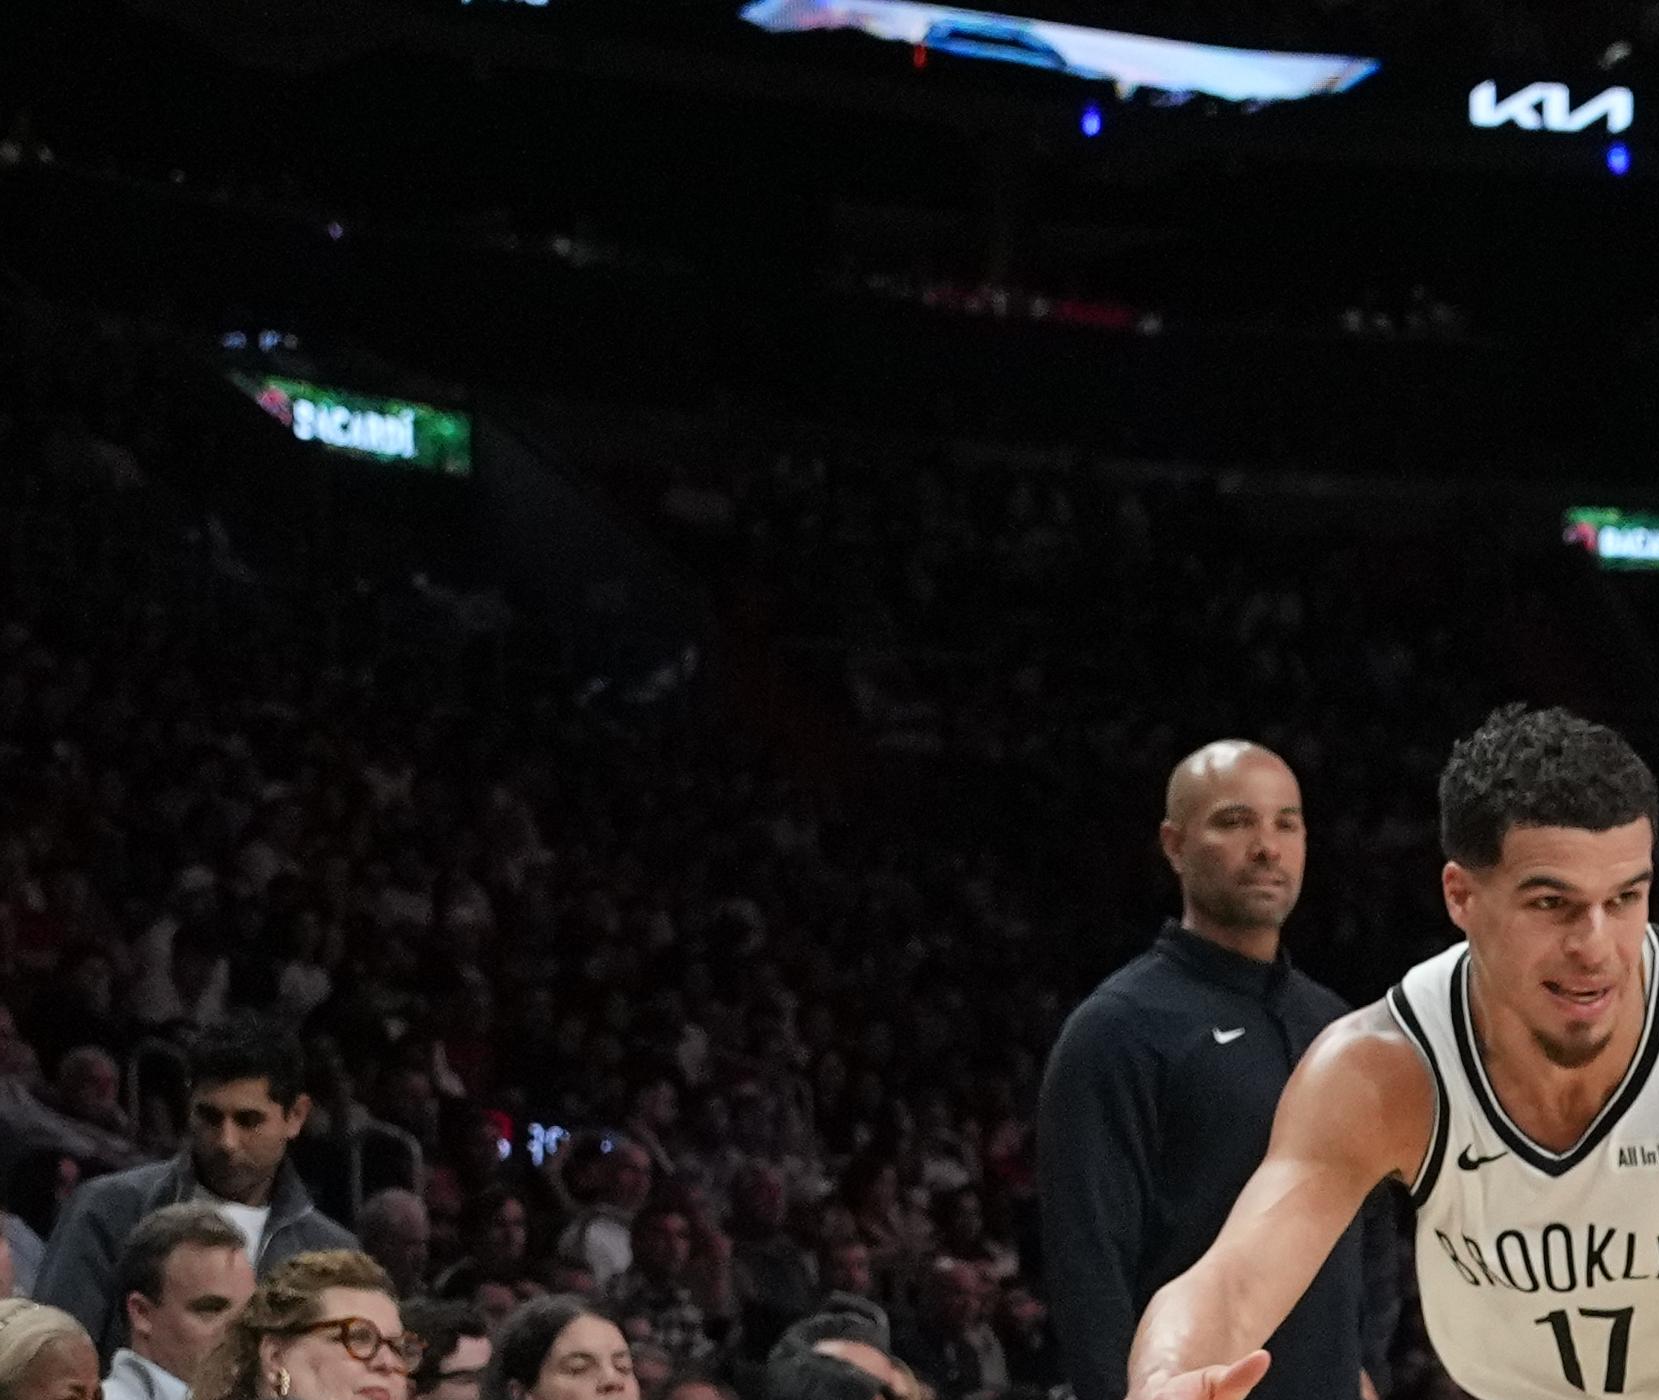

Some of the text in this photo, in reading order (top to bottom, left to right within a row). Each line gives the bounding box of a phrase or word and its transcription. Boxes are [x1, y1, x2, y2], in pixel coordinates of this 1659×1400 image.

[1618, 1147, 1637, 1167] All
[1641, 1146, 1656, 1165] In
[1534, 1306, 1635, 1394] 17
